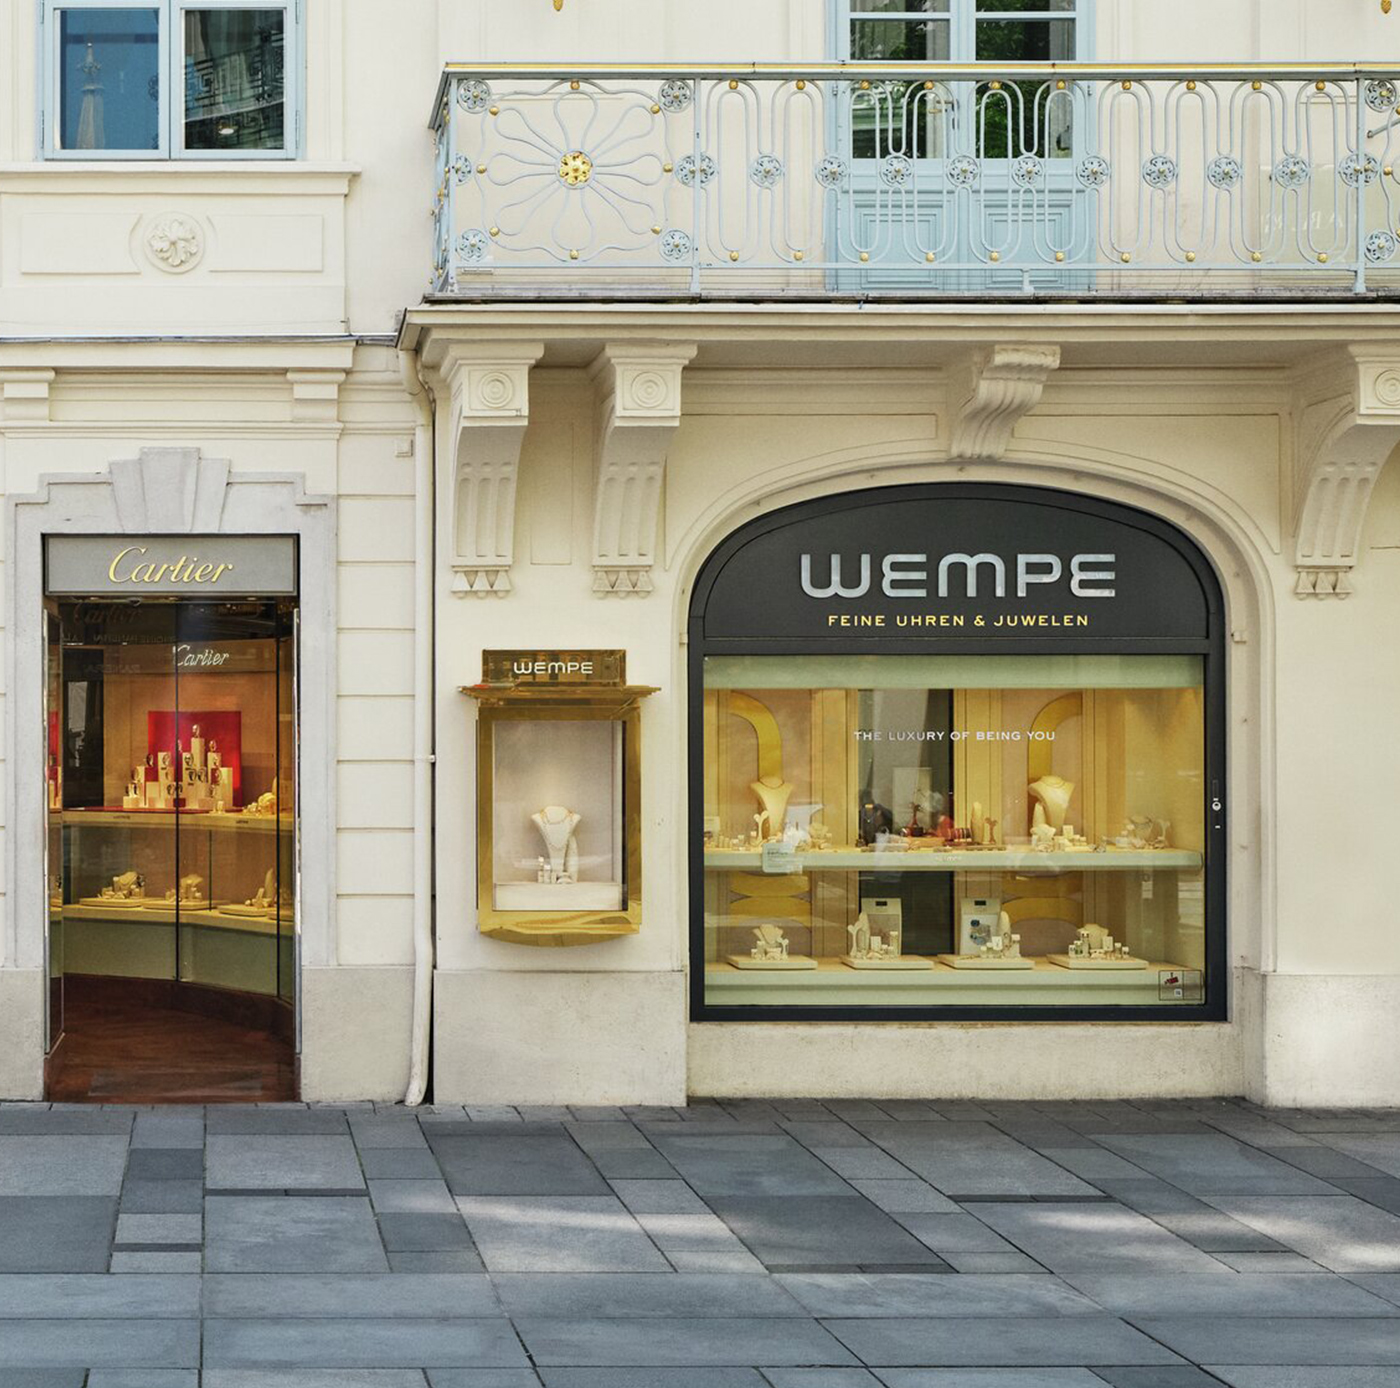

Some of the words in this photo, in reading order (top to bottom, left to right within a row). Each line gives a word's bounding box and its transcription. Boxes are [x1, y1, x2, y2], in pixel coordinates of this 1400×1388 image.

[108, 546, 234, 584] Cartier
[800, 551, 1117, 600] WEMPE
[828, 614, 886, 627] FEINE
[896, 614, 966, 627] UHREN
[973, 614, 986, 627] &
[993, 614, 1090, 627] JUWELEN
[173, 644, 230, 667] Cartier
[513, 660, 594, 675] WEMPE
[854, 730, 882, 742] THE
[888, 730, 945, 742] LUXURY
[950, 730, 970, 742] OF
[976, 730, 1021, 742] BEING
[1026, 730, 1056, 742] YOU
